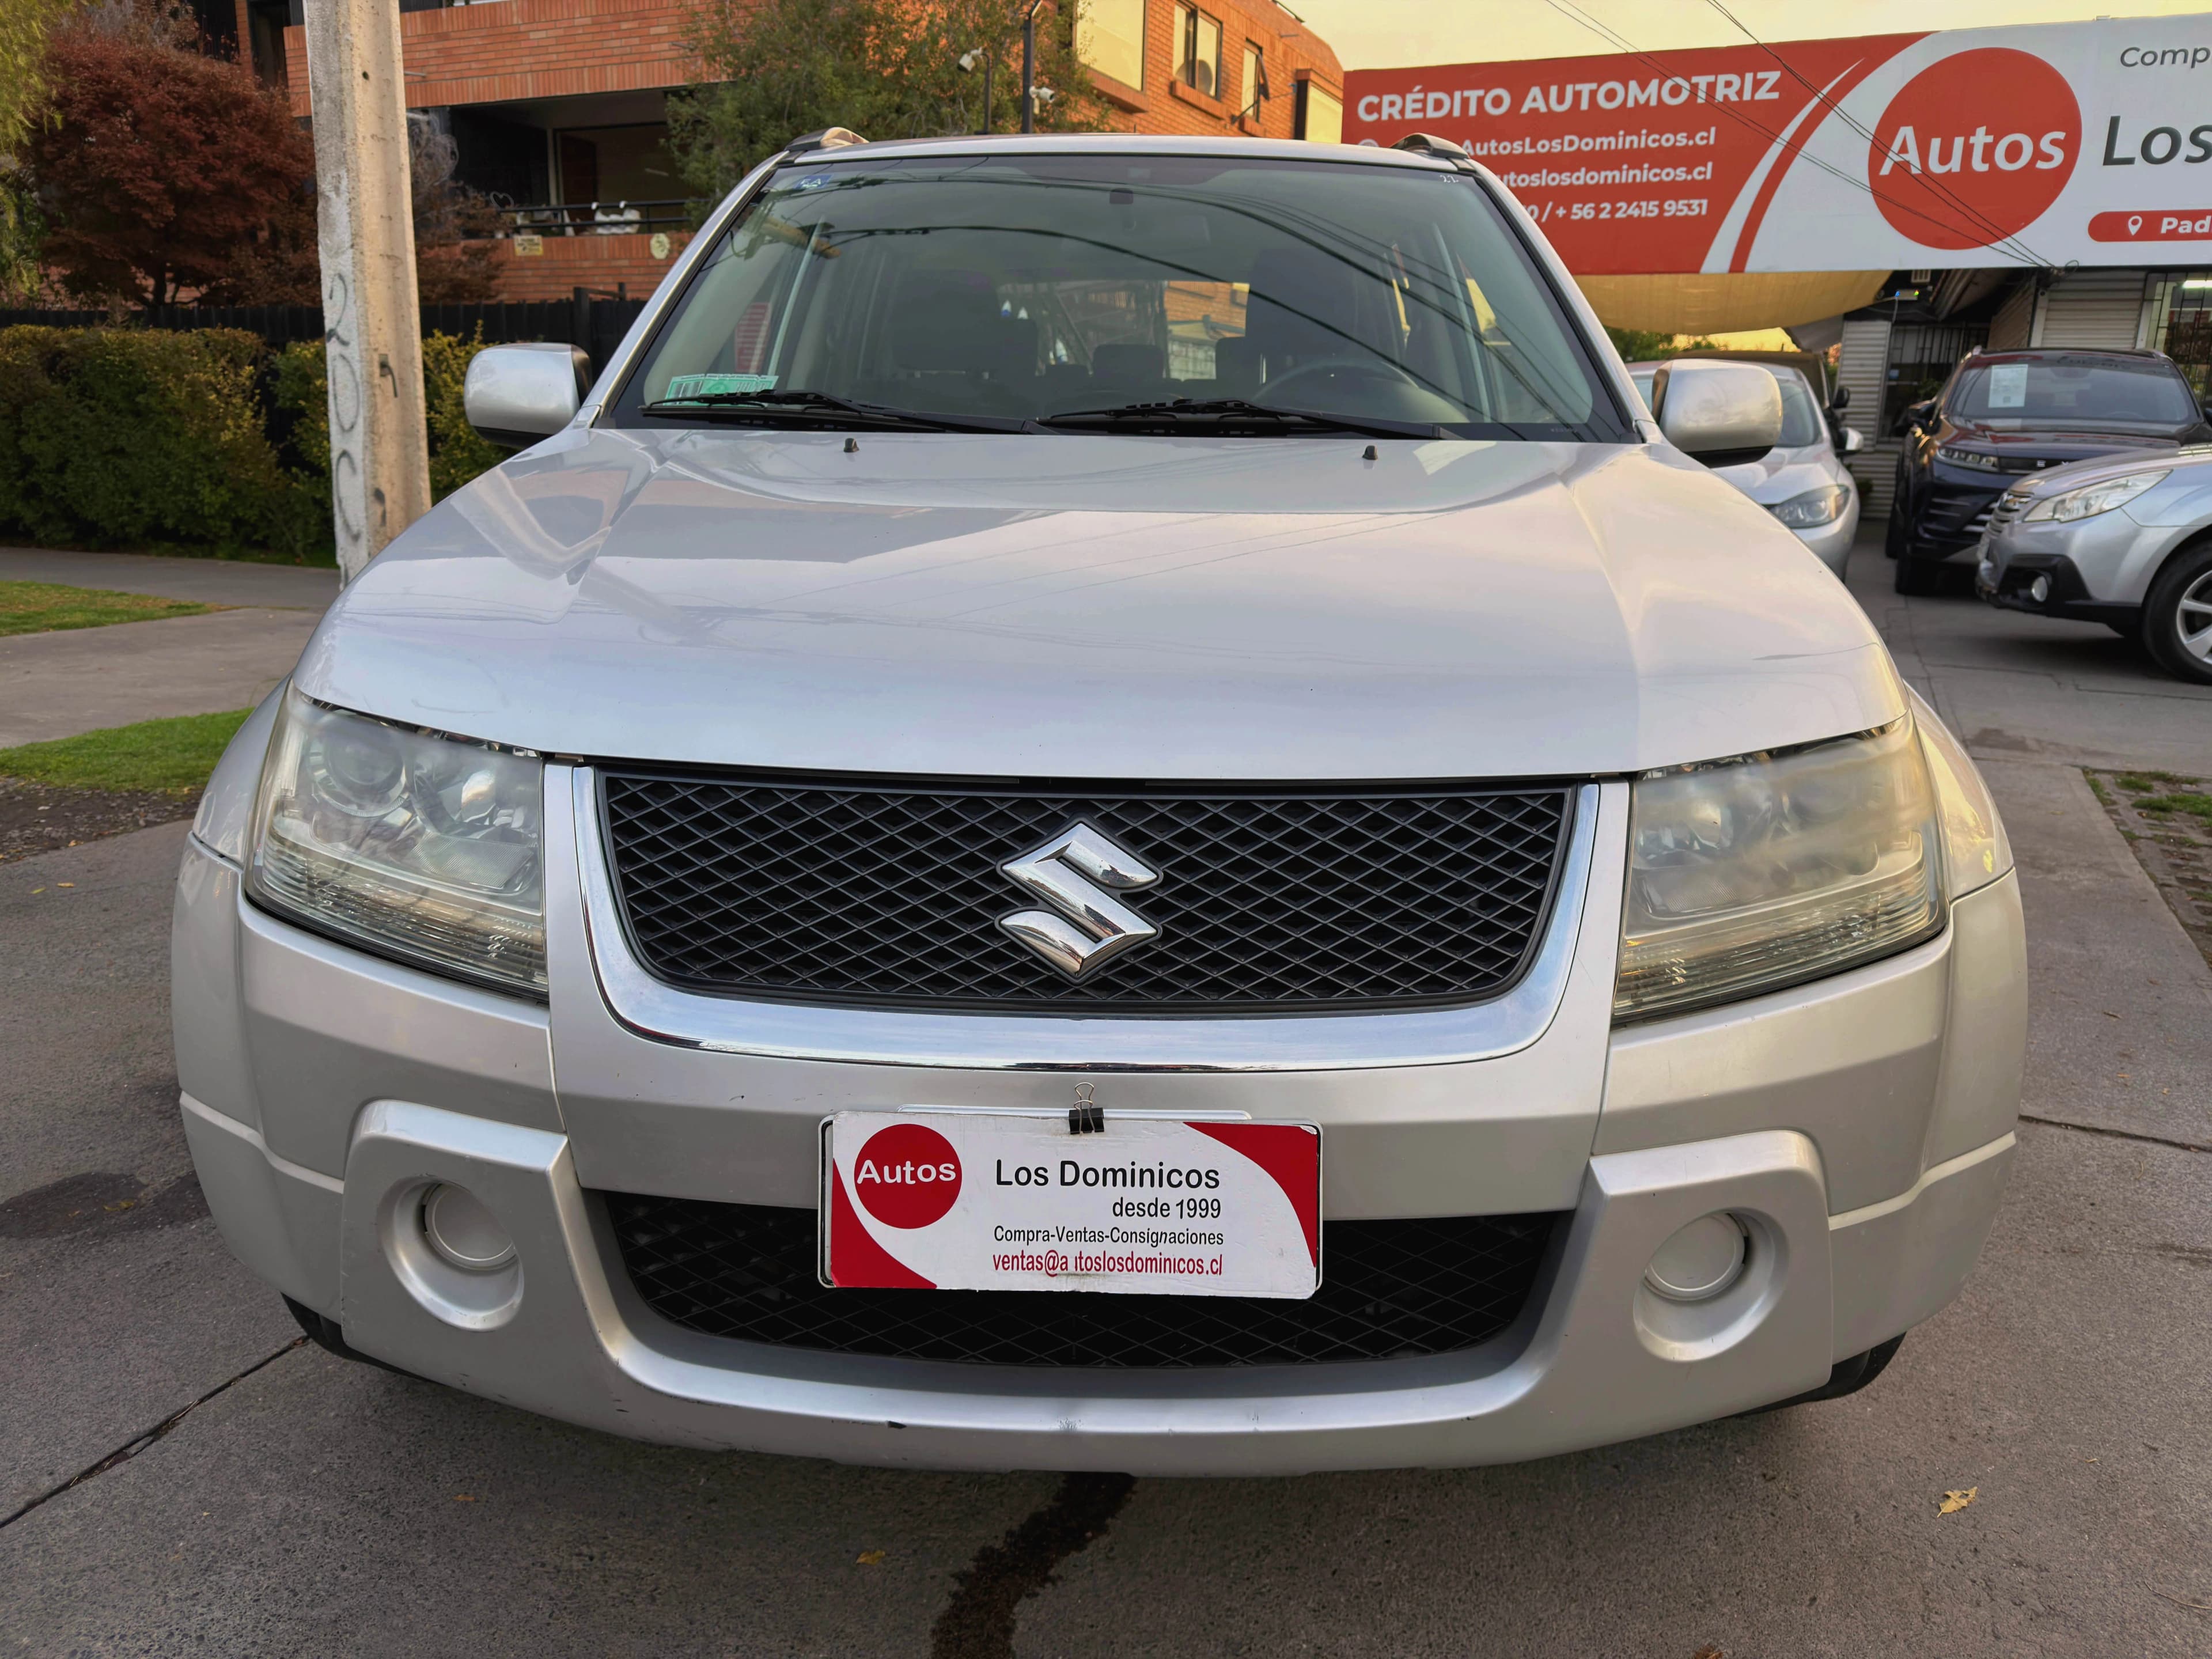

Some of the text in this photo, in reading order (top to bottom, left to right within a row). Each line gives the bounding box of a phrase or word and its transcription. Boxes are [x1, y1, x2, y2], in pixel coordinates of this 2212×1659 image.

[1357, 70, 1782, 123] CRÉDITO AUTOMOTRIZ
[1879, 124, 2067, 176] Autos
[2103, 115, 2212, 166] Los
[1570, 203, 1595, 220] 56
[1598, 202, 1611, 219] 2
[1615, 200, 1660, 218] 2415
[1663, 198, 1709, 217] 9531
[856, 1159, 957, 1185] Autos
[996, 1159, 1221, 1190] Los Dominicos
[1112, 1196, 1222, 1219] desde 1999
[994, 1225, 1224, 1248] Compra-Ventas-Consignaciones
